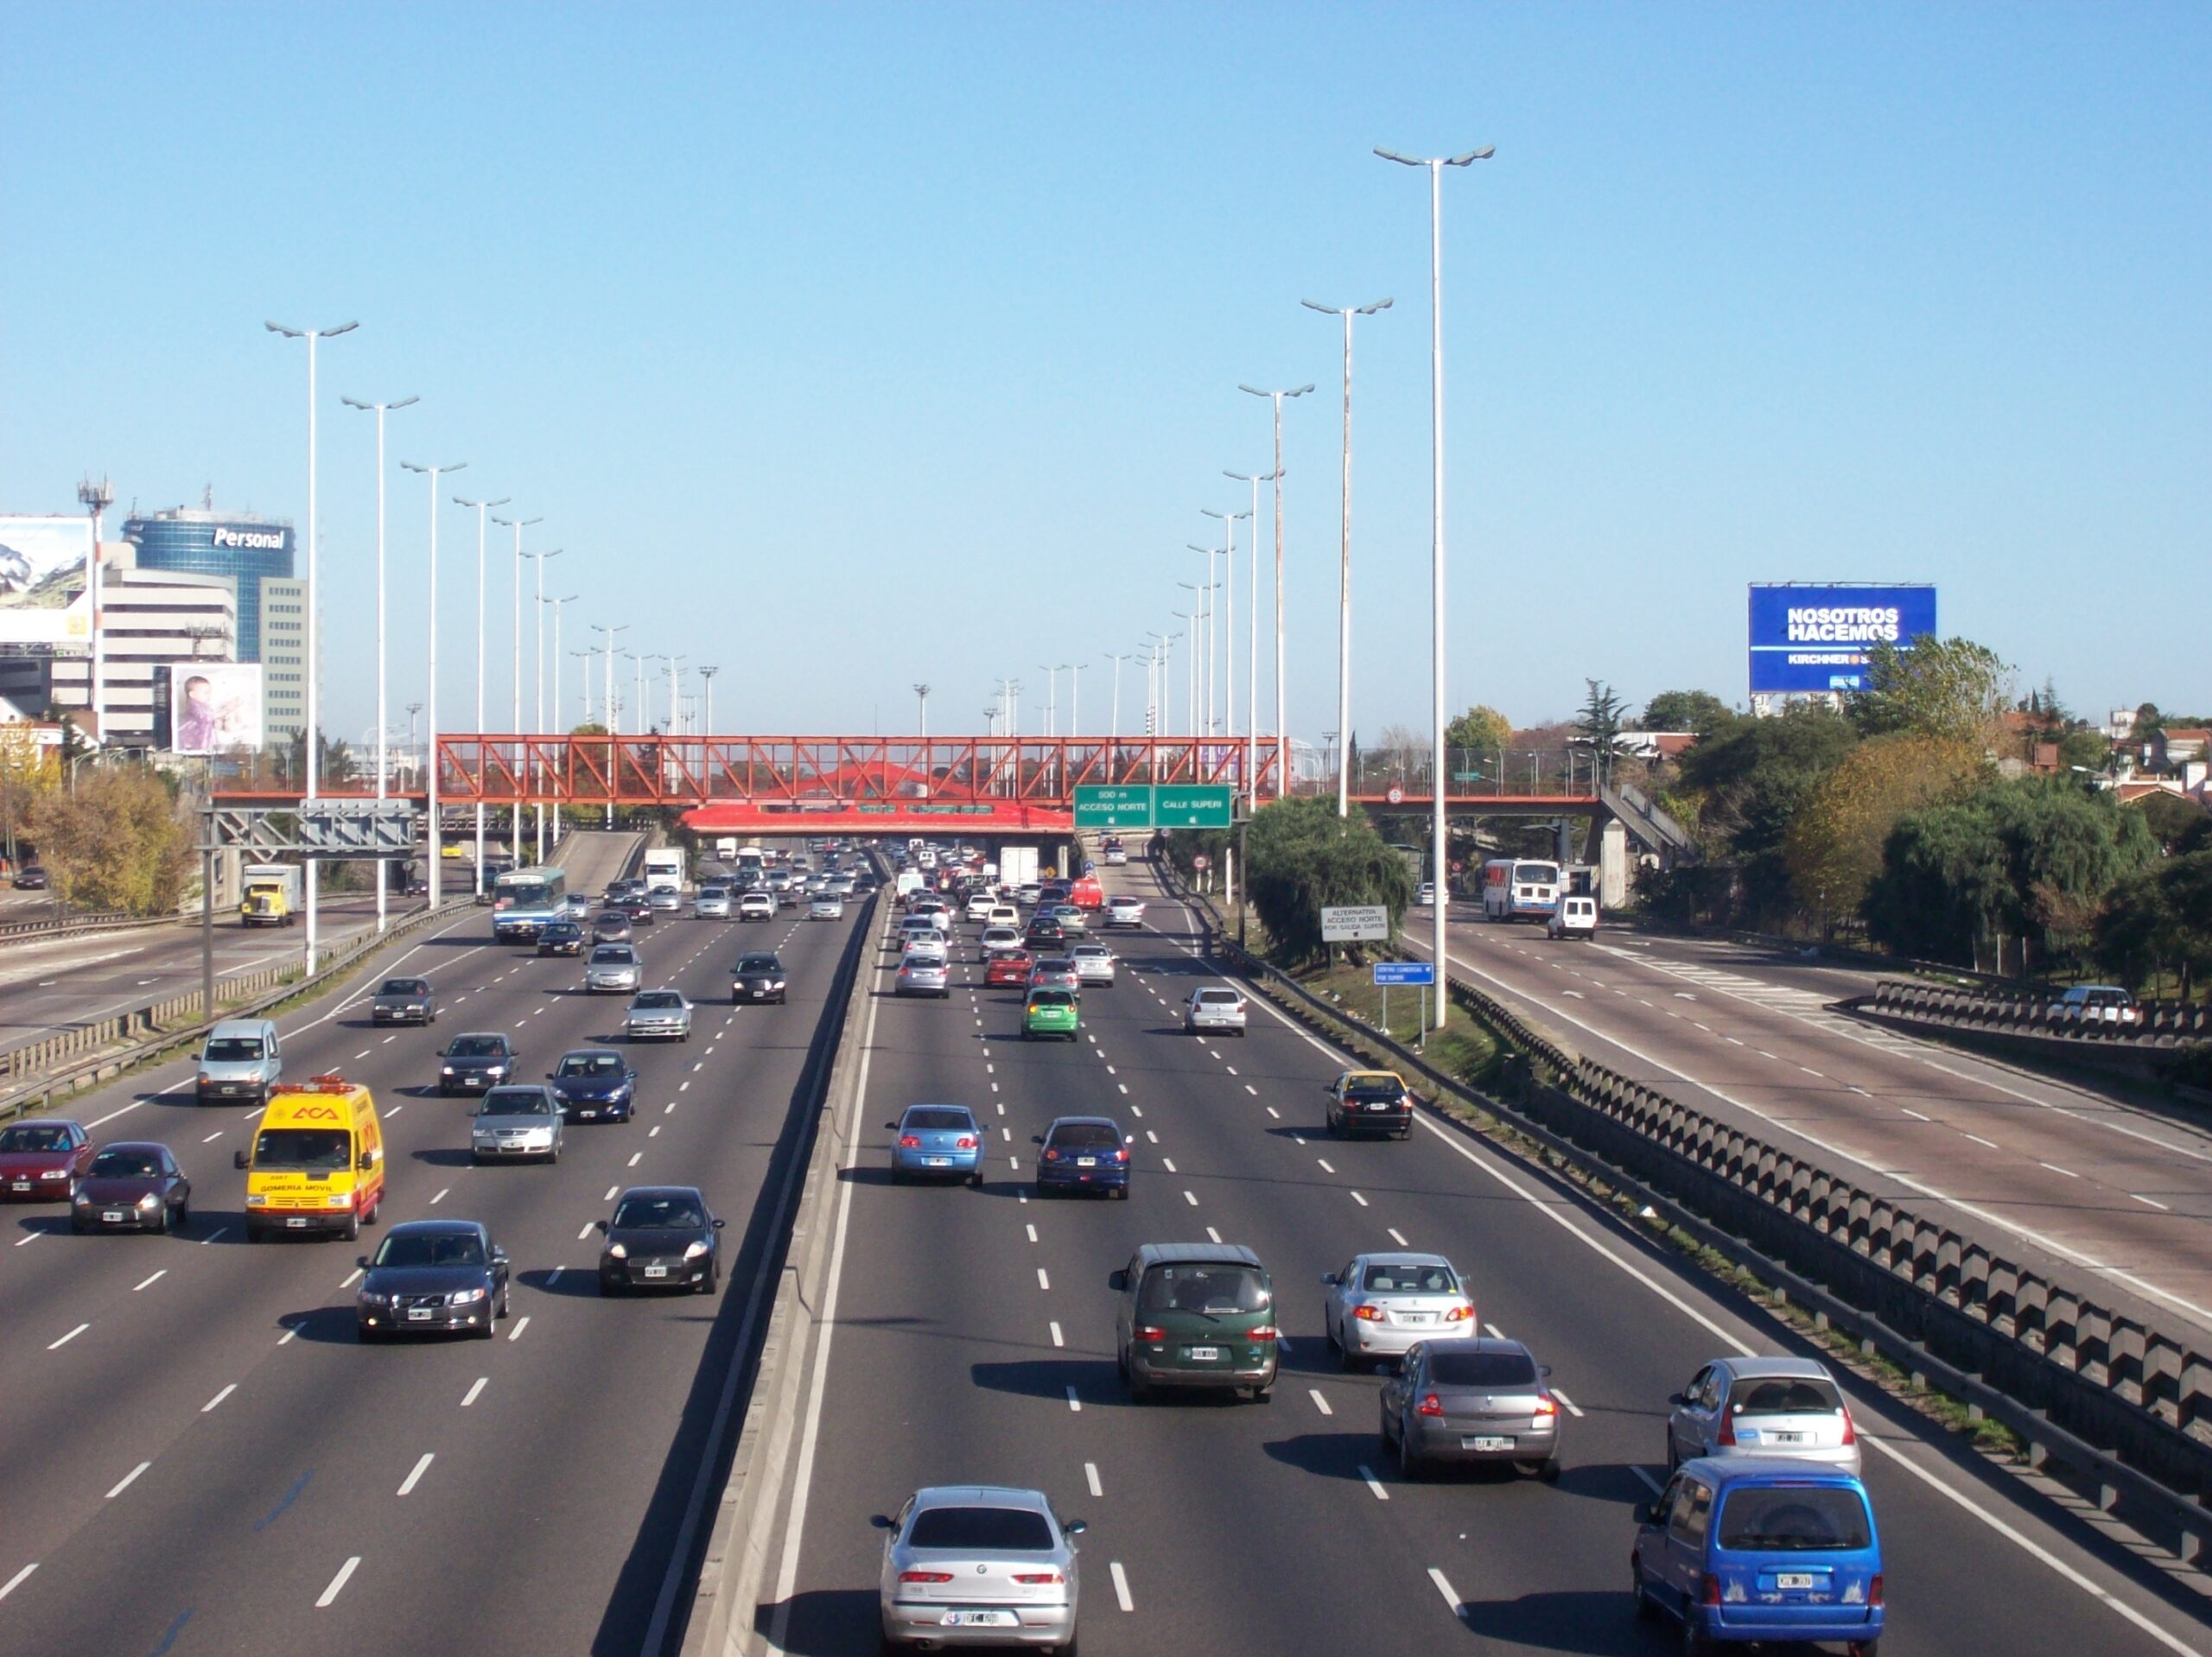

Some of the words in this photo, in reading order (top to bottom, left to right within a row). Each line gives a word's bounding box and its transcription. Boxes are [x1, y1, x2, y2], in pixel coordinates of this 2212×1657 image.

[213, 528, 285, 549] Personal
[1788, 608, 1899, 624] NOSOTROS
[1788, 624, 1899, 641] HACEMOS
[1788, 654, 1850, 664] KIRCHNER
[1098, 790, 1116, 799] 500
[1078, 803, 1115, 812] ACCESO
[1191, 800, 1222, 809] SUPERI
[292, 1108, 340, 1120] ACA
